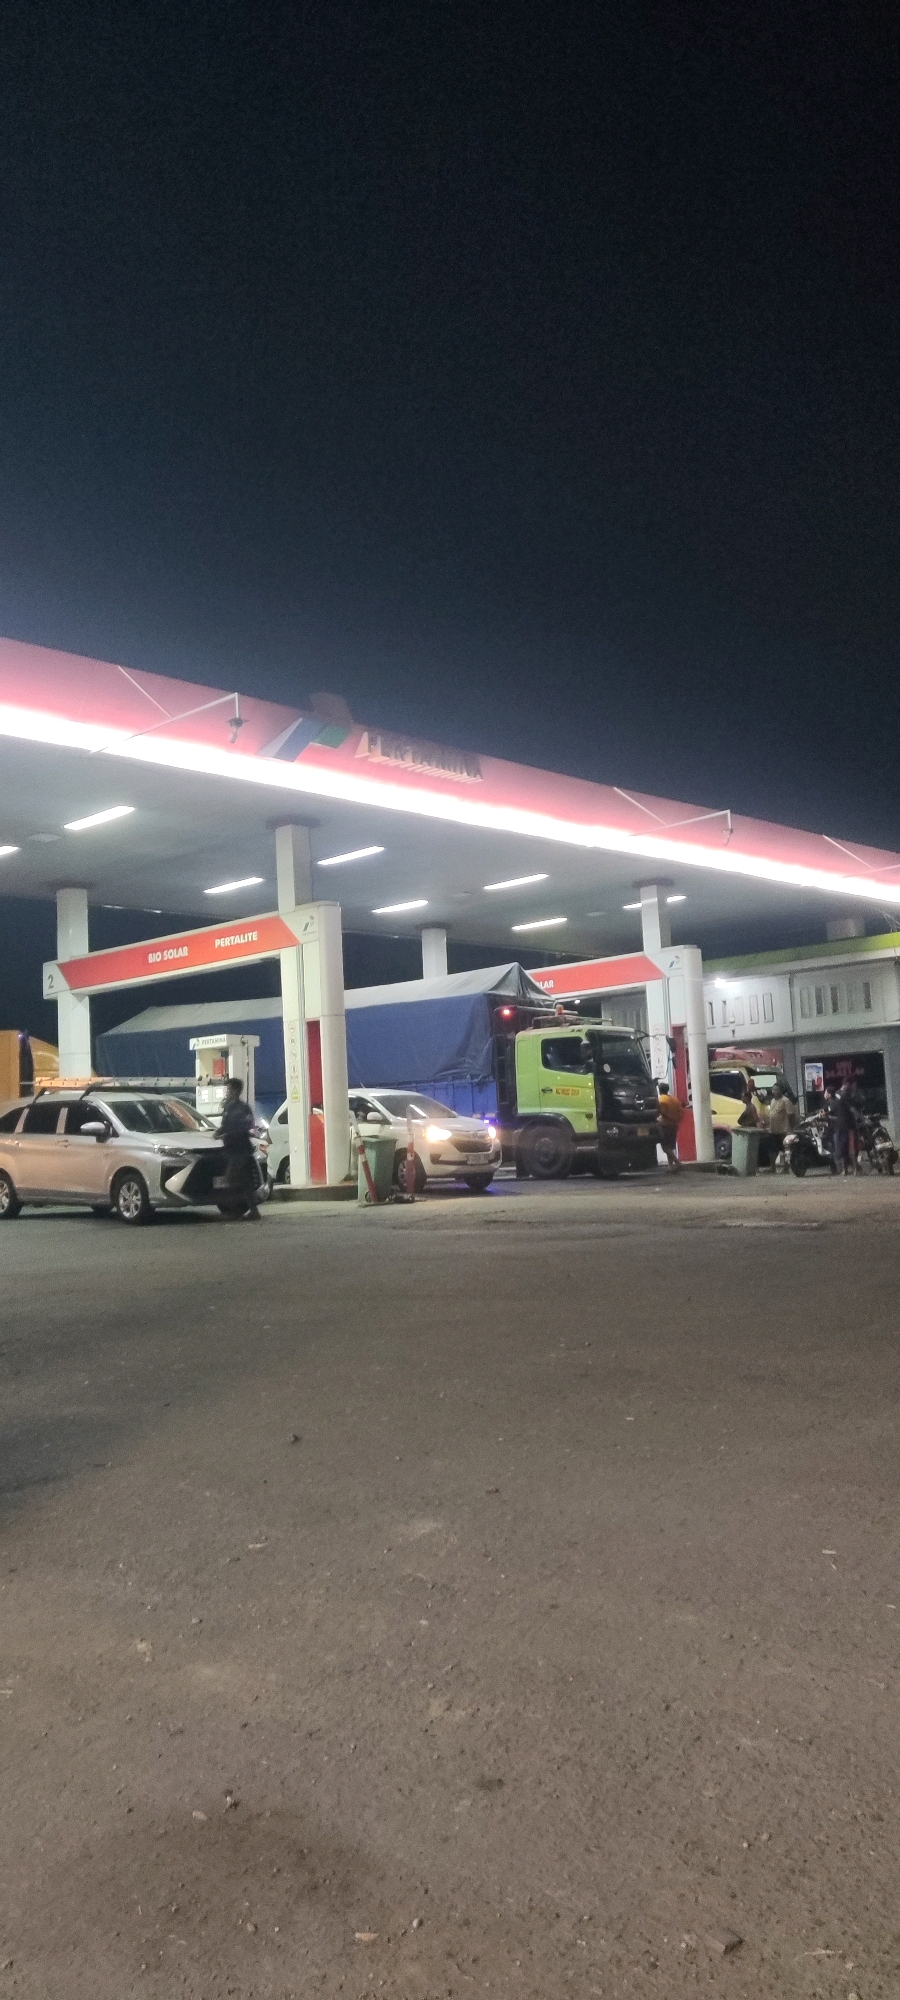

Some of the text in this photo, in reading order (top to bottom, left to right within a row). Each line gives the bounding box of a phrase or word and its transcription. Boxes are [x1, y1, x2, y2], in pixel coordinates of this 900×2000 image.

[148, 931, 258, 964] BIO SOLAR PERTALITE
[47, 974, 54, 989] 2
